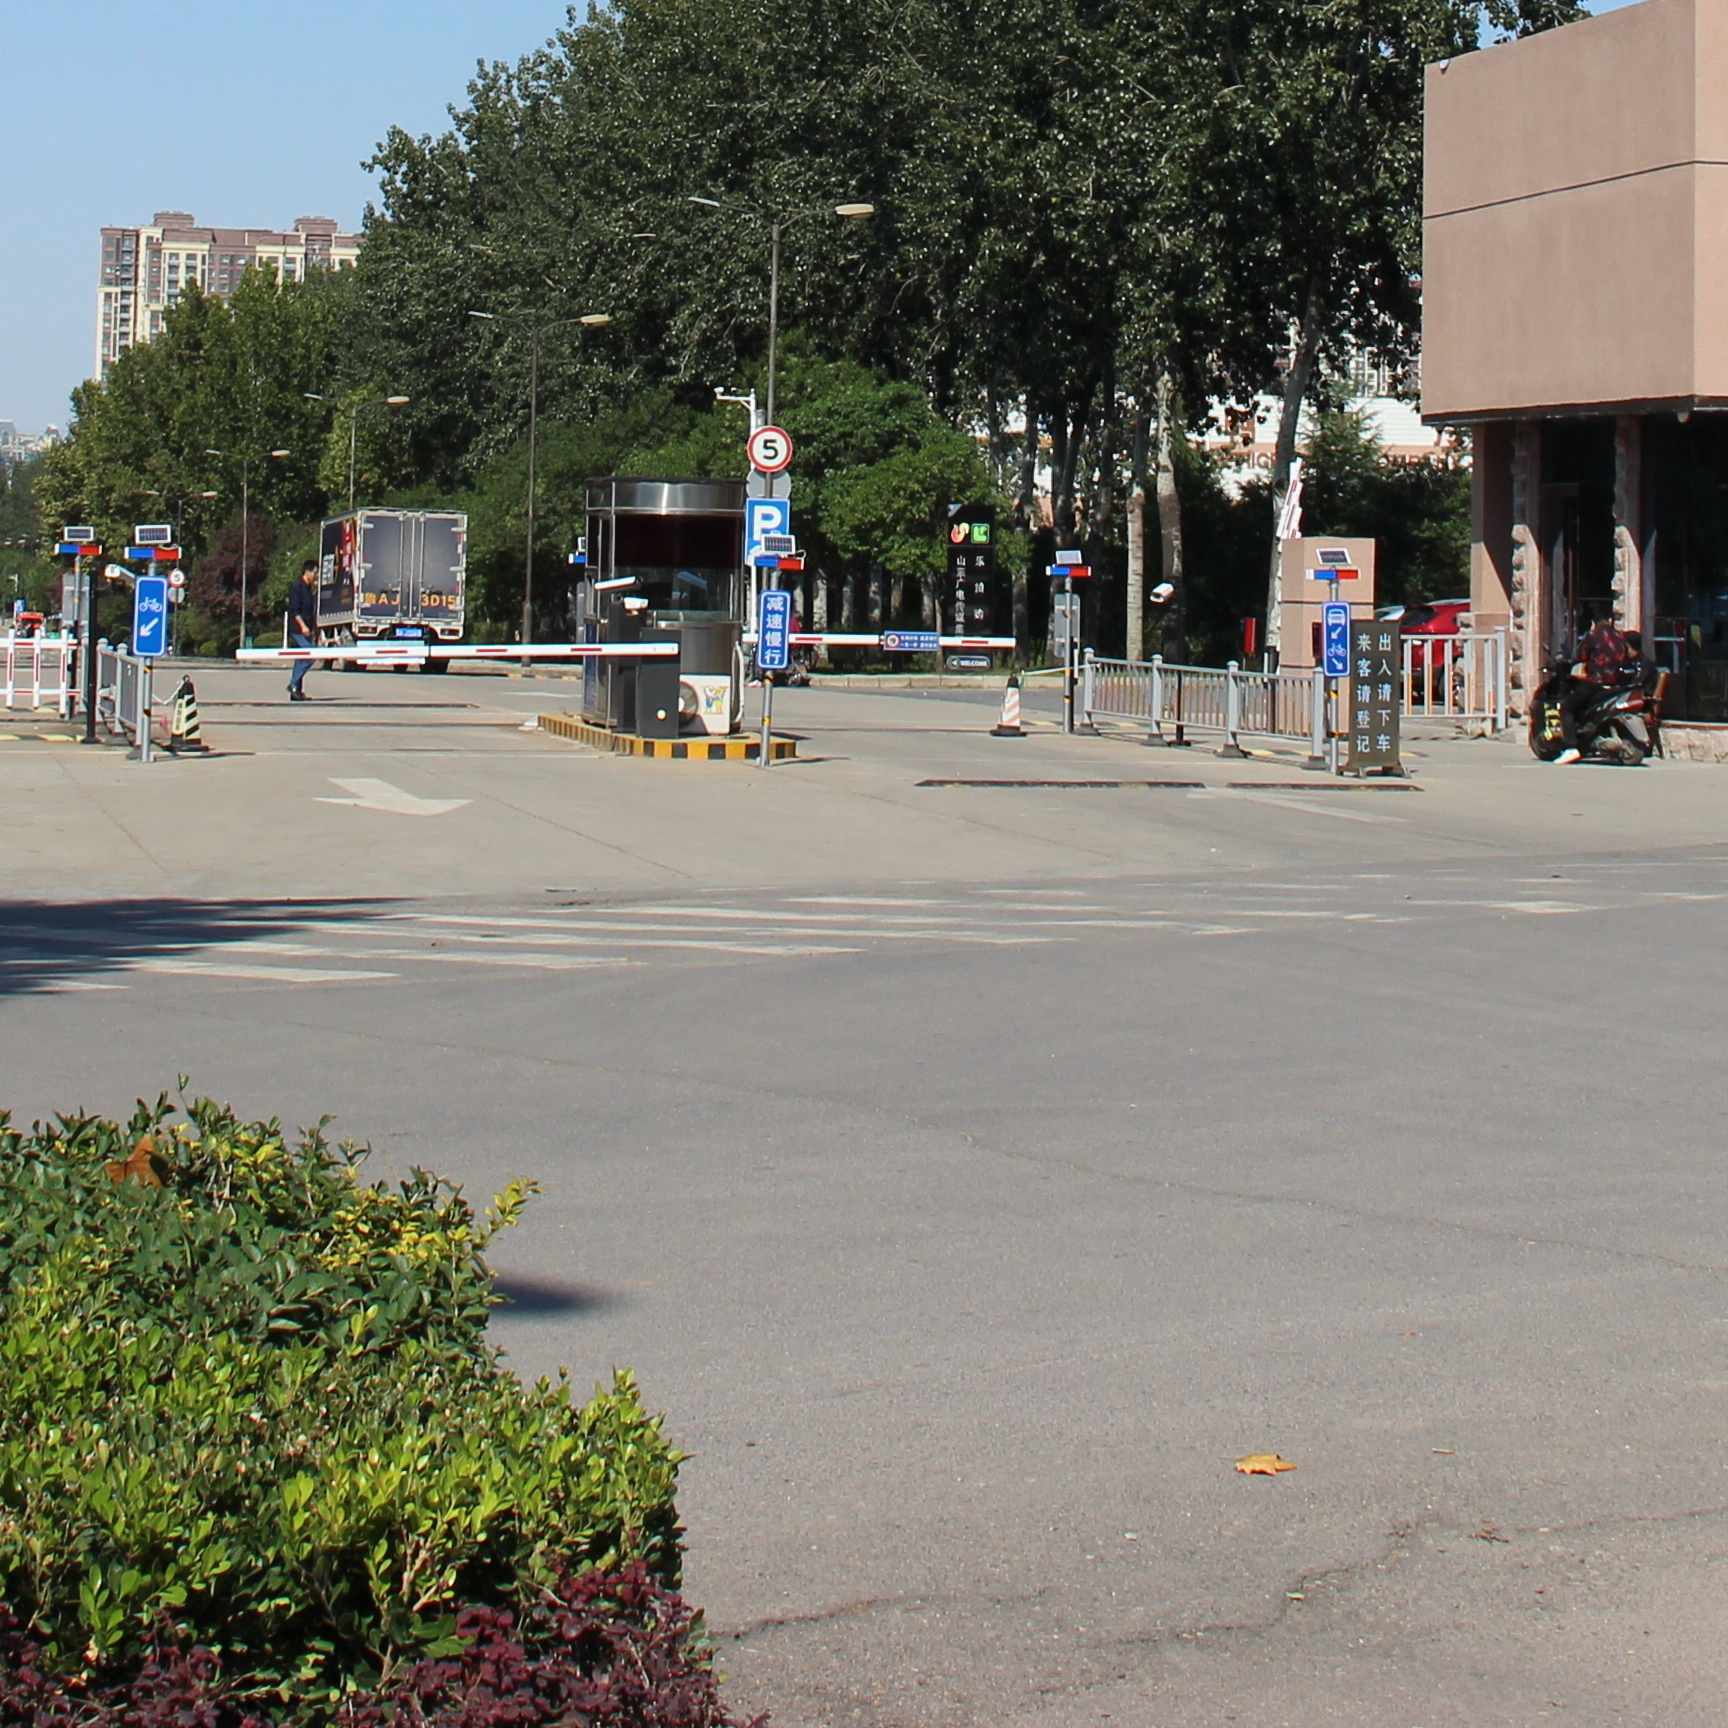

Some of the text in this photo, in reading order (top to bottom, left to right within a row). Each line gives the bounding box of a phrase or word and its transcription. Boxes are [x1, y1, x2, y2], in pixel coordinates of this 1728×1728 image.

[763, 439, 778, 460] 5
[753, 505, 782, 541] P
[764, 597, 784, 665] 减速慢行
[1357, 633, 1372, 753] 来客请登记
[1376, 633, 1392, 753] 出入请下车
